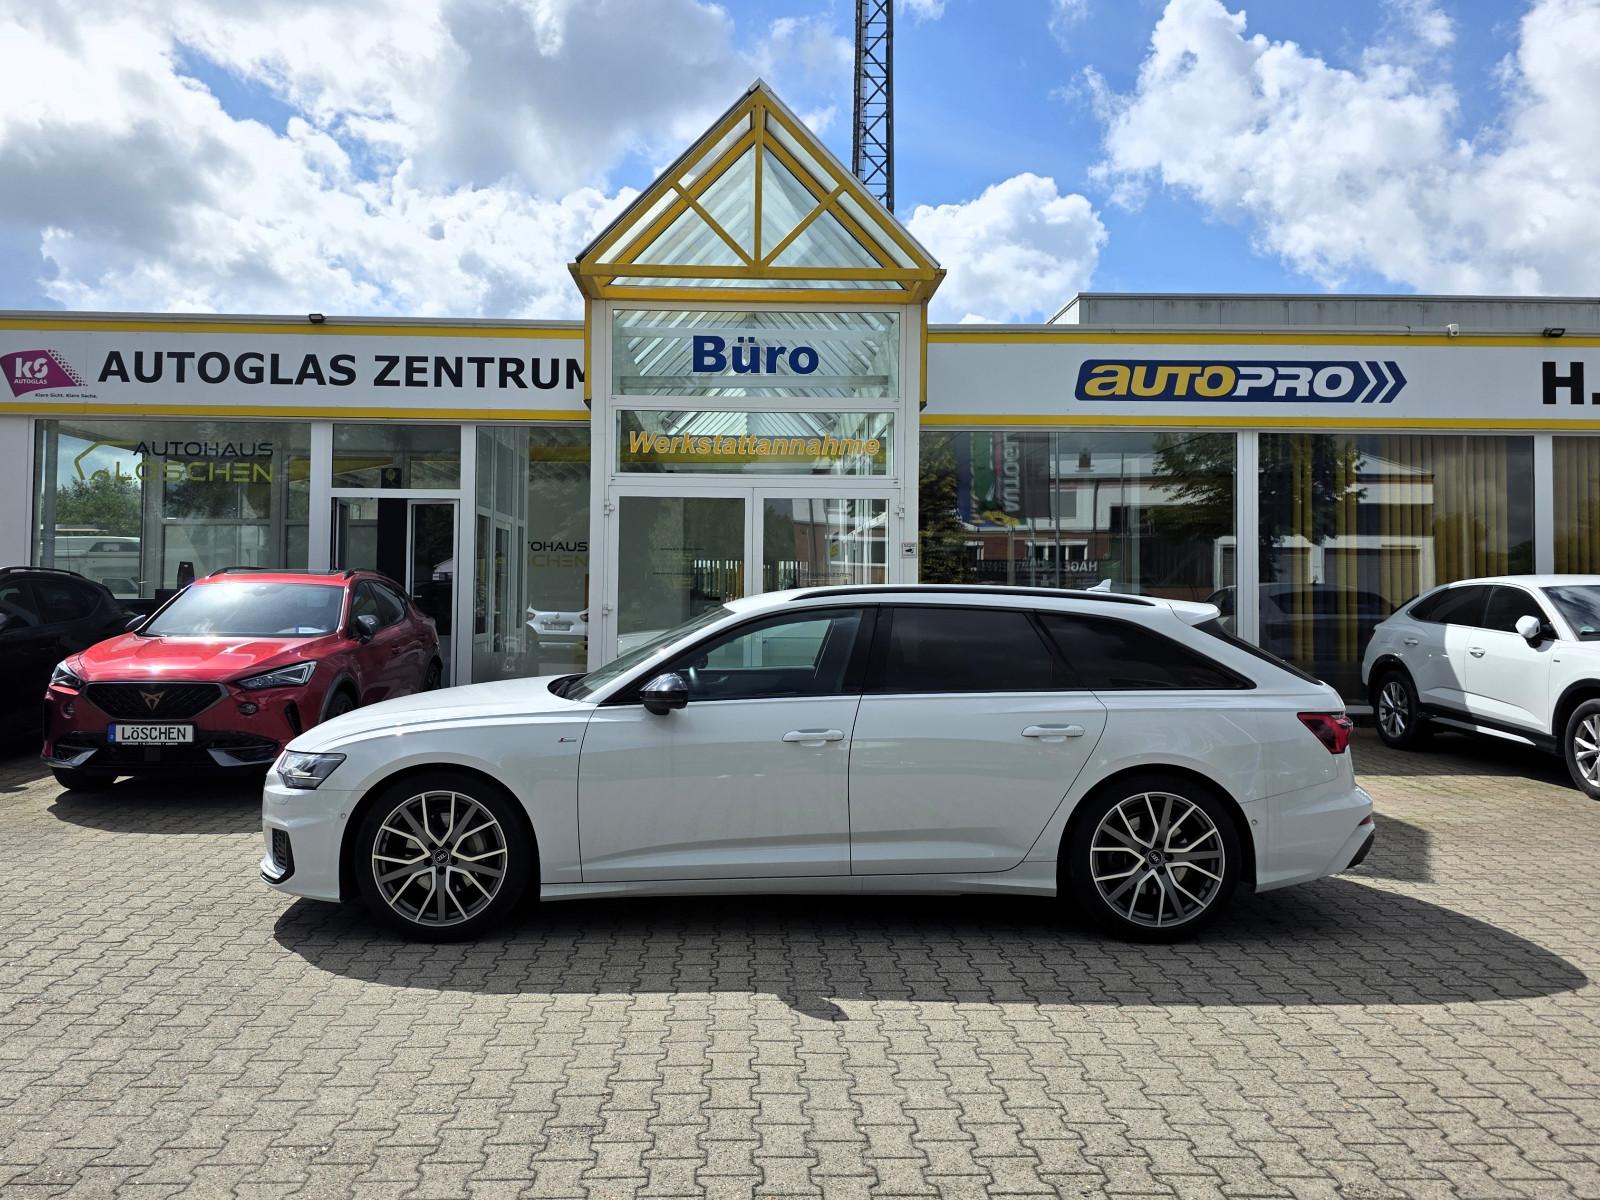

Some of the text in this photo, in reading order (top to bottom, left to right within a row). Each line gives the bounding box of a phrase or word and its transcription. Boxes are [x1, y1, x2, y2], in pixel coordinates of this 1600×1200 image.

[692, 335, 819, 375] Büro
[98, 351, 356, 386] AUTOGLAS
[133, 441, 273, 457] AUTOHAUS
[629, 431, 880, 456] Werkstattannahme
[528, 541, 588, 552] OHAUS
[528, 554, 589, 568] CHEN
